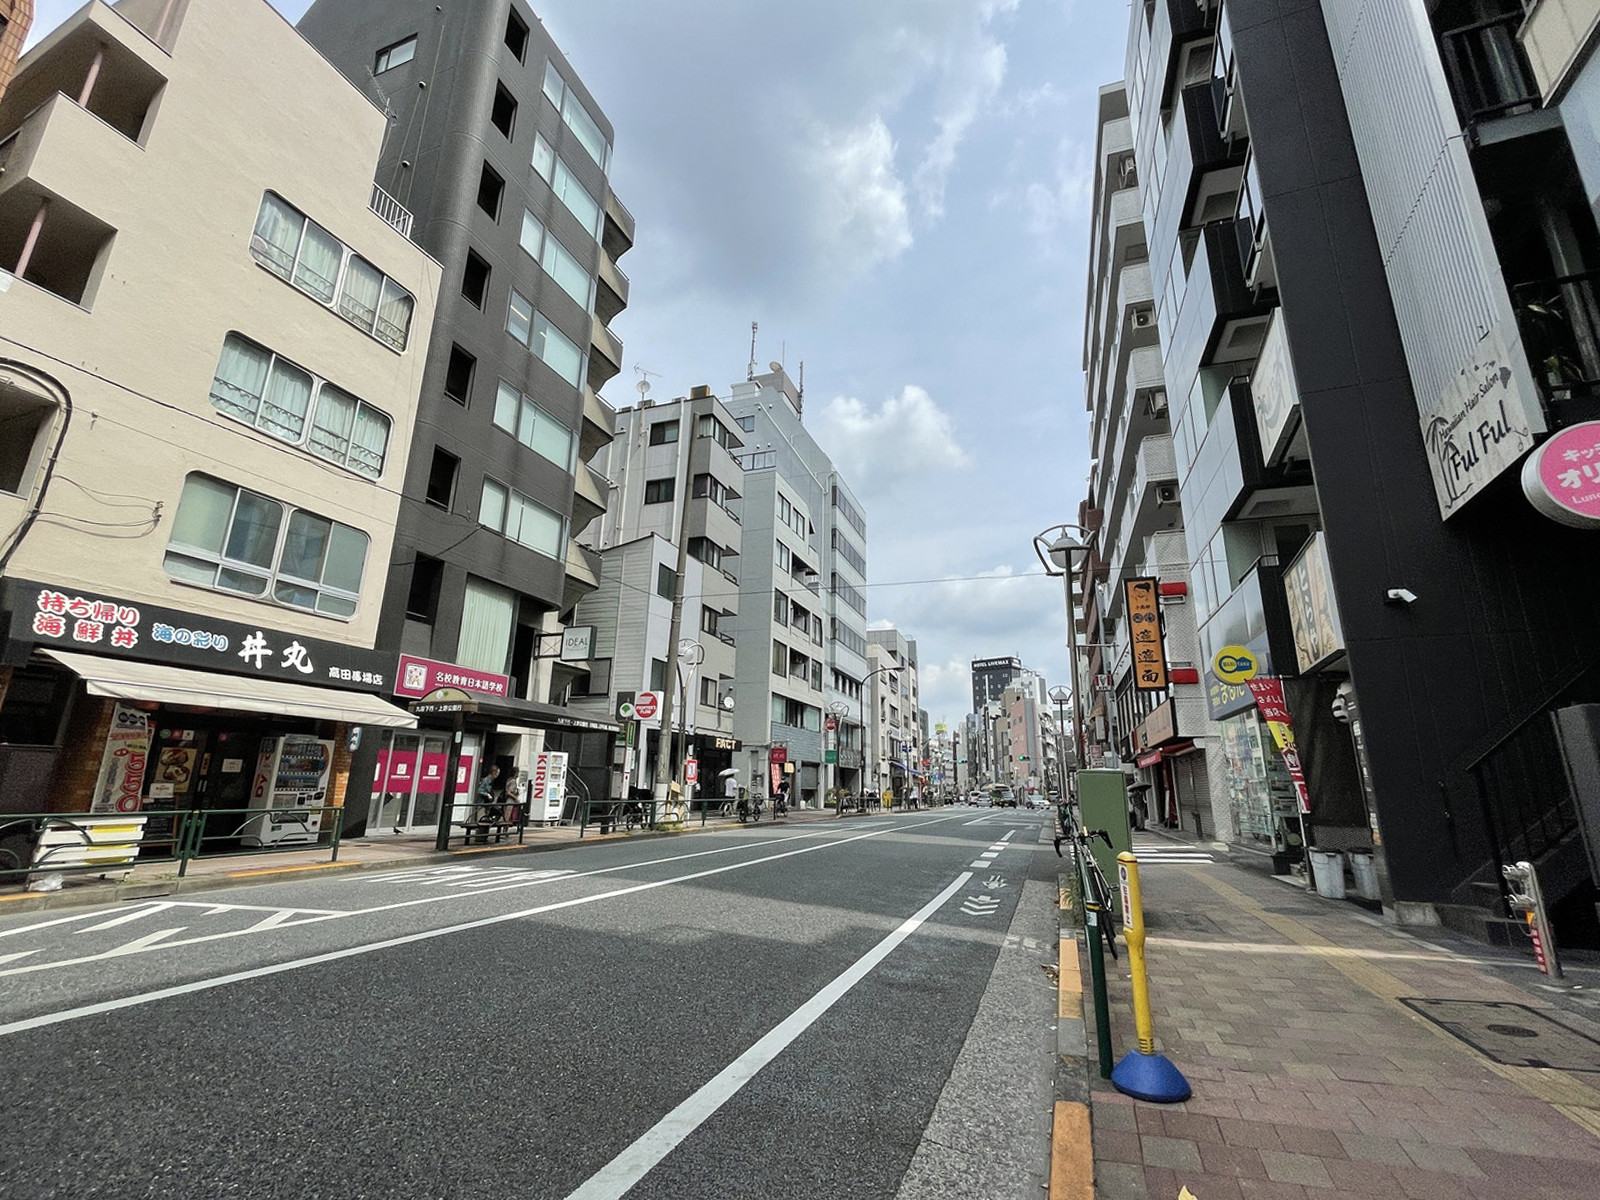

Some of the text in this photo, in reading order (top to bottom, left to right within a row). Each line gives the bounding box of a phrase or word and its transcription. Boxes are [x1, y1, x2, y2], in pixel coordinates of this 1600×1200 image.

[1464, 392, 1480, 413] Hair
[1479, 372, 1499, 398] Salon
[1450, 400, 1511, 481] Ful Ful
[38, 590, 139, 627] 持ち帰り
[33, 612, 139, 648] 海鮮丼
[152, 623, 228, 651] 海の彩り
[566, 637, 588, 647] IDEAL
[238, 631, 314, 674] 丼丸
[329, 666, 383, 686] 高田馬場店
[716, 738, 736, 750] FACT
[533, 754, 548, 799] KIRIN
